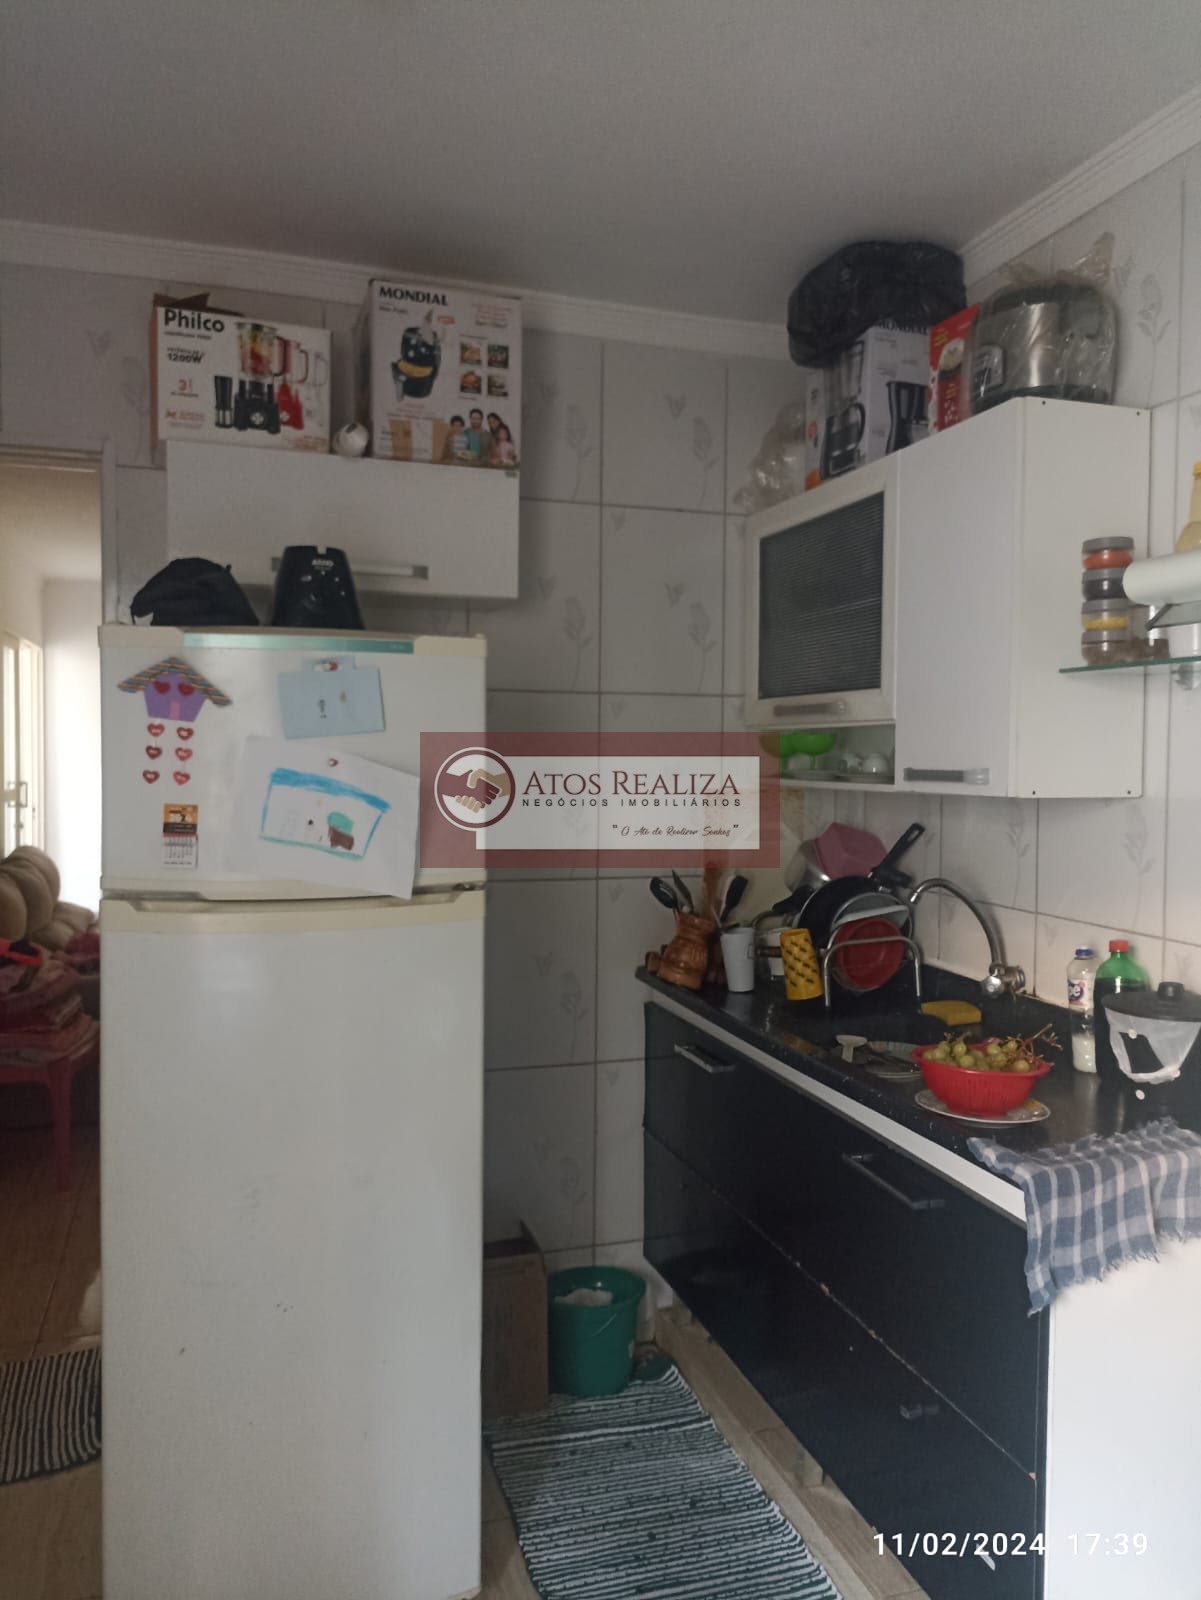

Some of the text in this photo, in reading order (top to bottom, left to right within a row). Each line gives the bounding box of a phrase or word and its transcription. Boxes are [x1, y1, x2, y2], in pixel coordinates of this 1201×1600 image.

[379, 286, 449, 306] MONDIAL
[164, 308, 225, 333] Philco
[167, 352, 204, 364] 1200W
